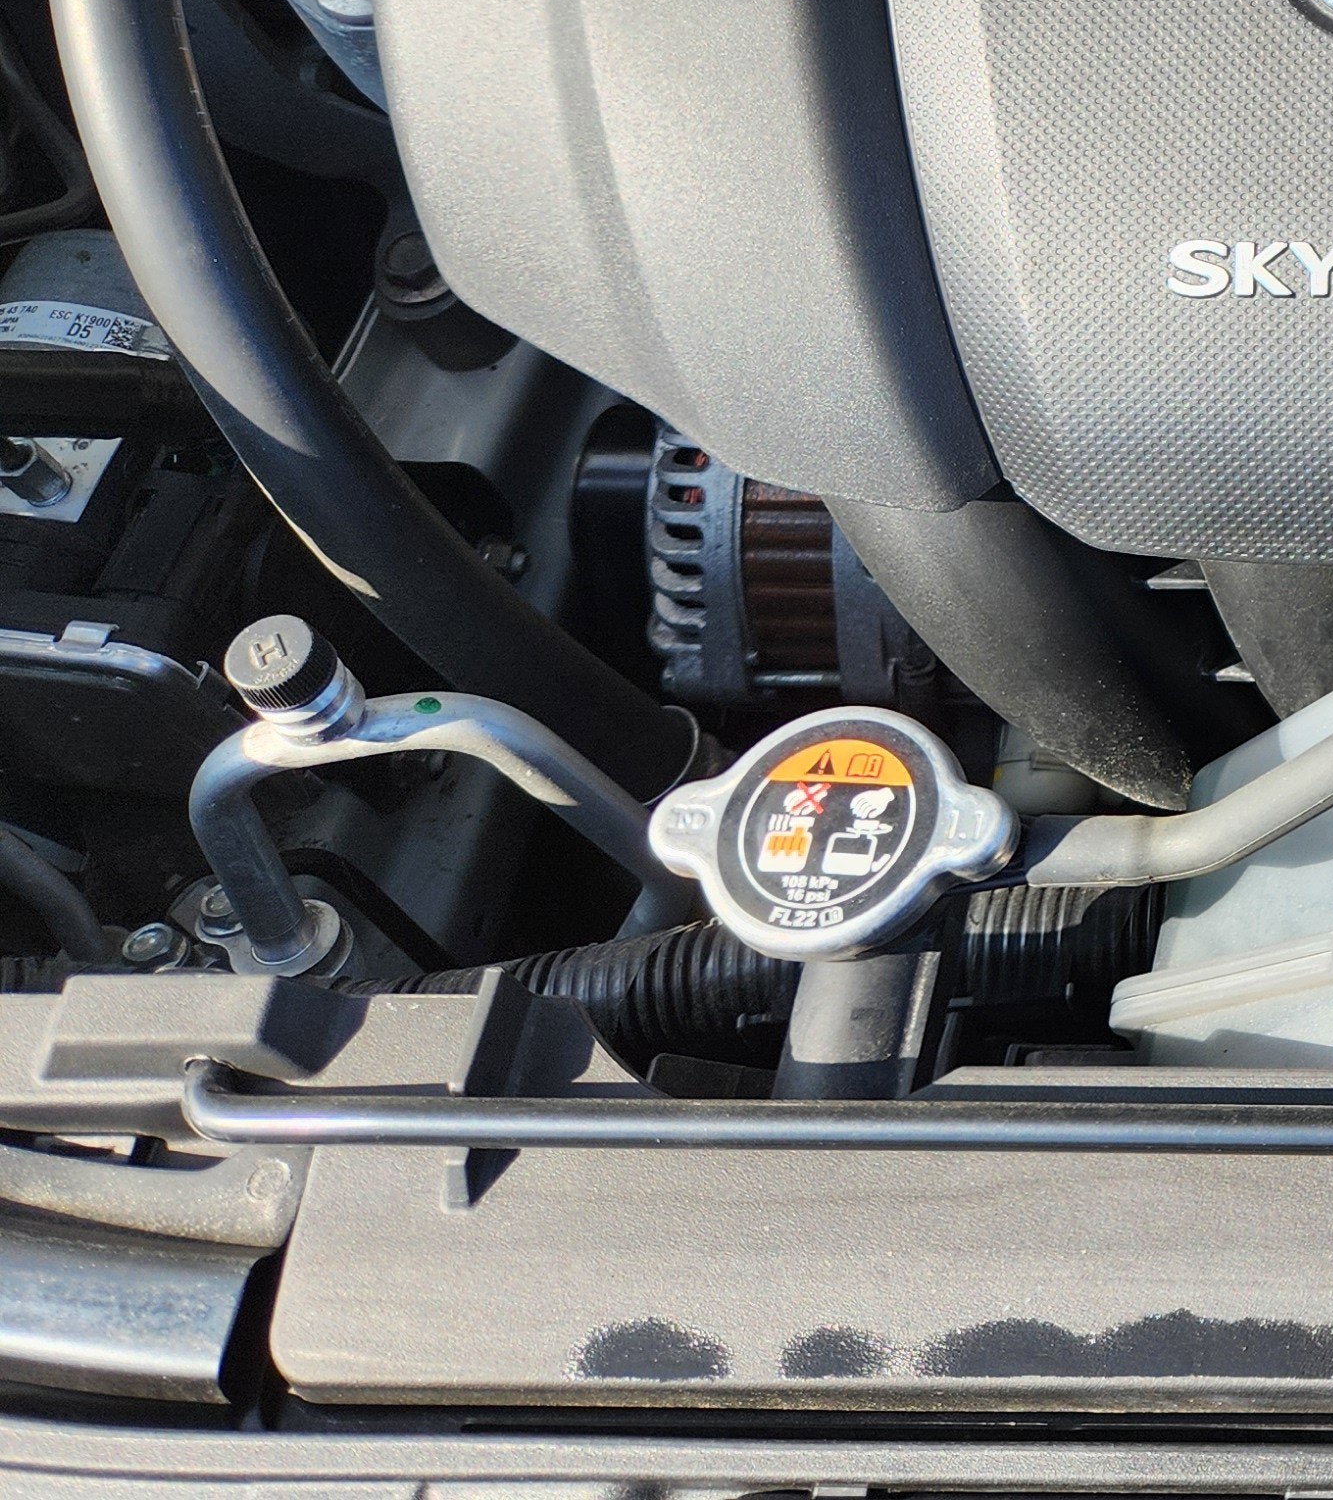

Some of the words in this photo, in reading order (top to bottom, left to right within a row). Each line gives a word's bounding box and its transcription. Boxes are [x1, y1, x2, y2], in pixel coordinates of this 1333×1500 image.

[50, 309, 72, 320] ESC
[75, 313, 111, 328] K1900
[66, 323, 93, 339] D5
[948, 809, 985, 840] 1.1
[781, 874, 808, 889] 108
[808, 875, 839, 890] kPa
[786, 888, 806, 902] 16
[804, 889, 832, 904] psi
[768, 906, 819, 928] FL22
